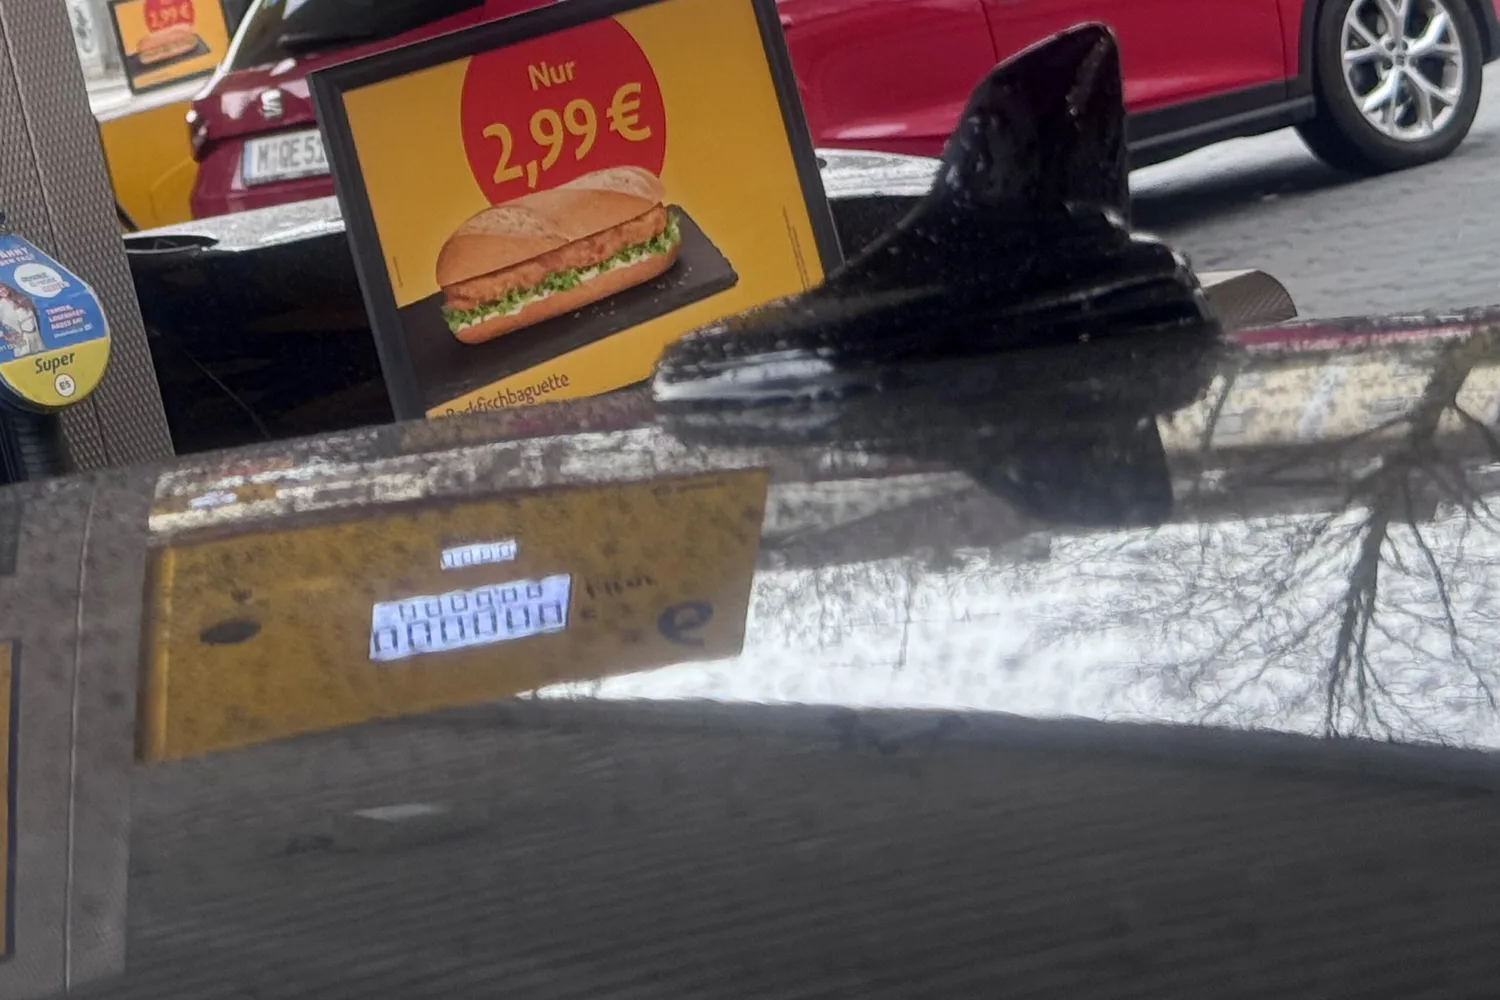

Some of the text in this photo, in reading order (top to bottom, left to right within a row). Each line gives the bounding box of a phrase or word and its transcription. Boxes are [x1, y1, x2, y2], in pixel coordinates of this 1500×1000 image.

[527, 60, 575, 91] Nur
[482, 82, 651, 189] 2,99 €
[35, 352, 75, 374] Super
[59, 380, 71, 391] E5
